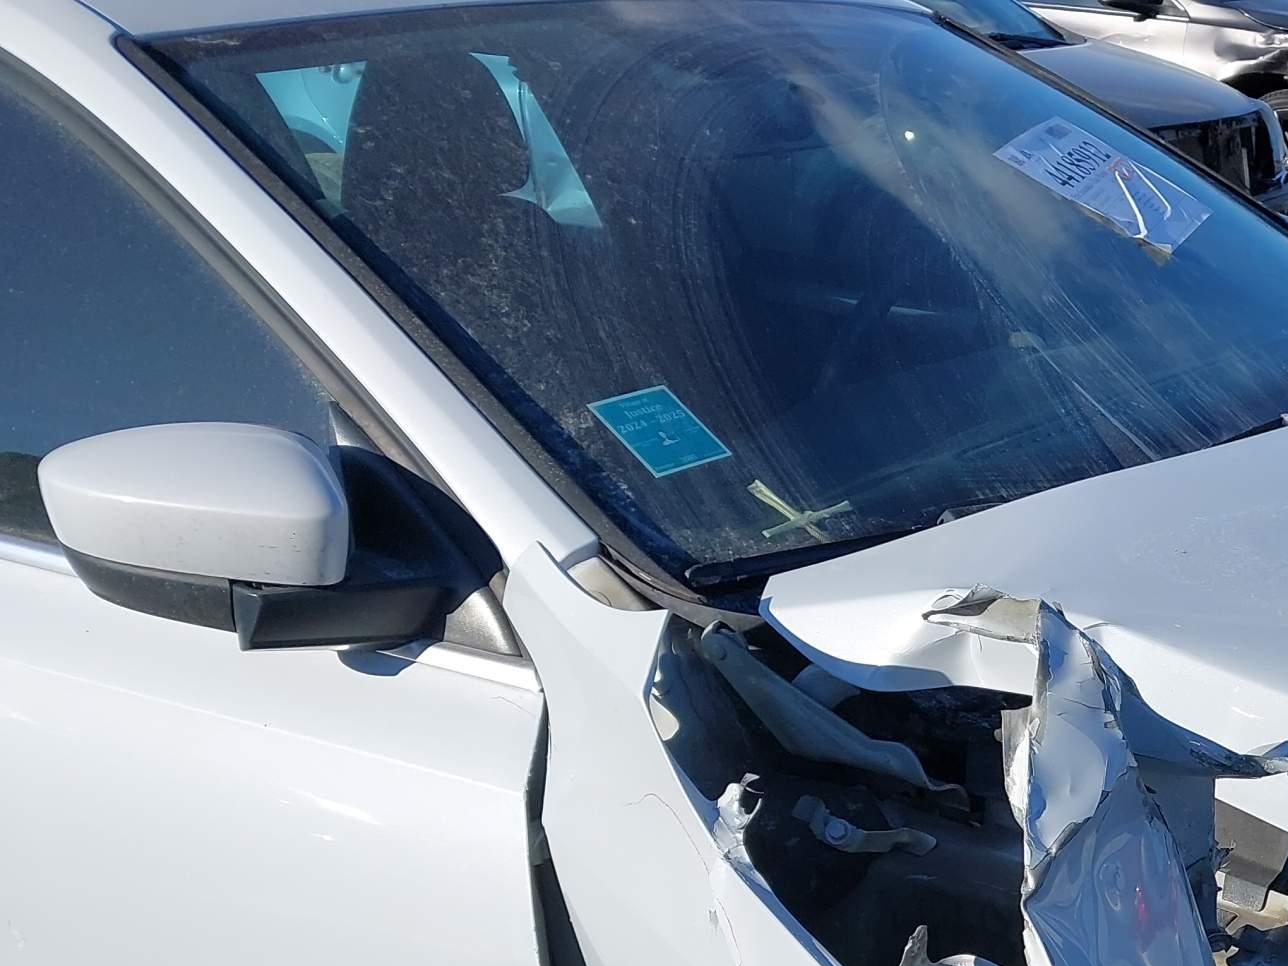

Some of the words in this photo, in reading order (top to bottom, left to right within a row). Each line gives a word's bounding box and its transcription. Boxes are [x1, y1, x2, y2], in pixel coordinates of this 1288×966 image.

[1044, 140, 1112, 188] 44185912
[617, 419, 648, 434] 2024
[655, 409, 686, 424] 2025
[624, 404, 663, 419] Justice
